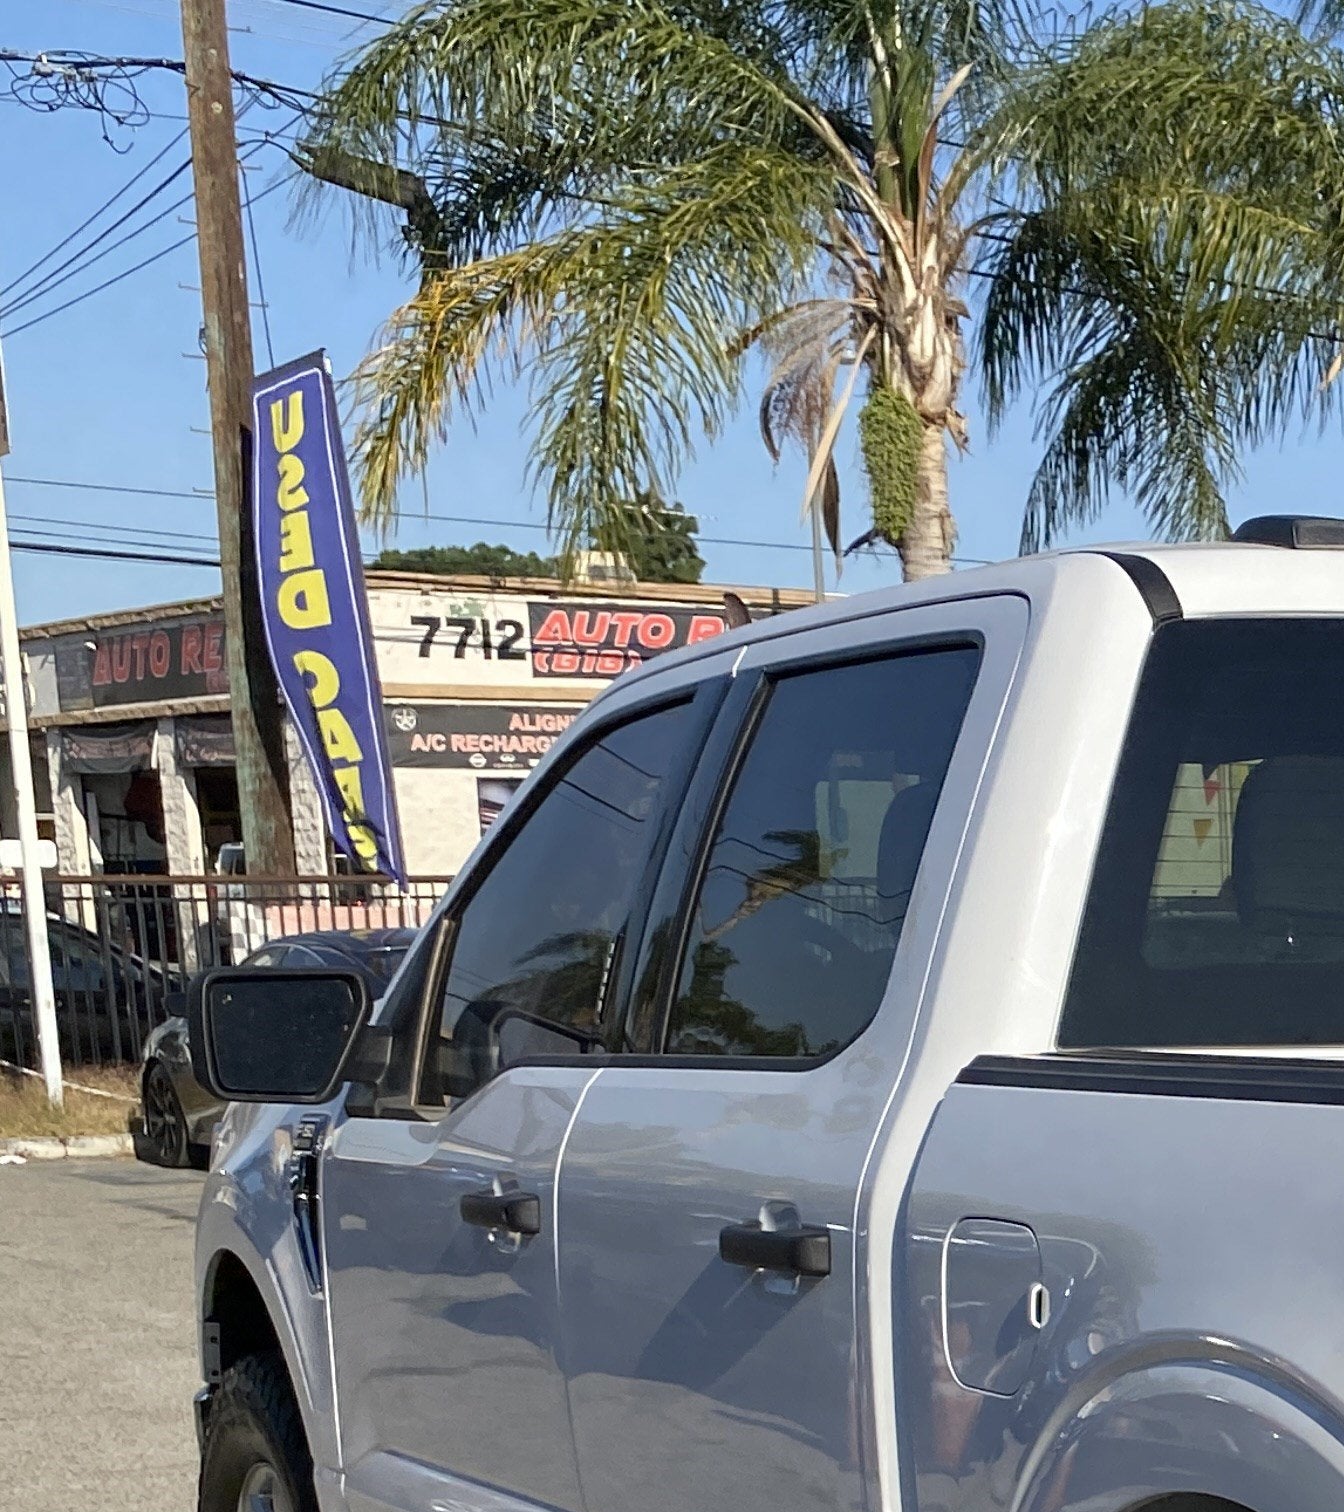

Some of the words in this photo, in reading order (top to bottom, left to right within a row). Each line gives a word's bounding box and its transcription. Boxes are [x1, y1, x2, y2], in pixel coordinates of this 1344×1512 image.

[411, 615, 527, 660] 7712
[533, 609, 676, 649] AUTO
[92, 630, 170, 686] AUTO
[508, 713, 577, 732] ALIGN
[410, 733, 447, 753] A/C
[450, 735, 559, 754] RECHARG
